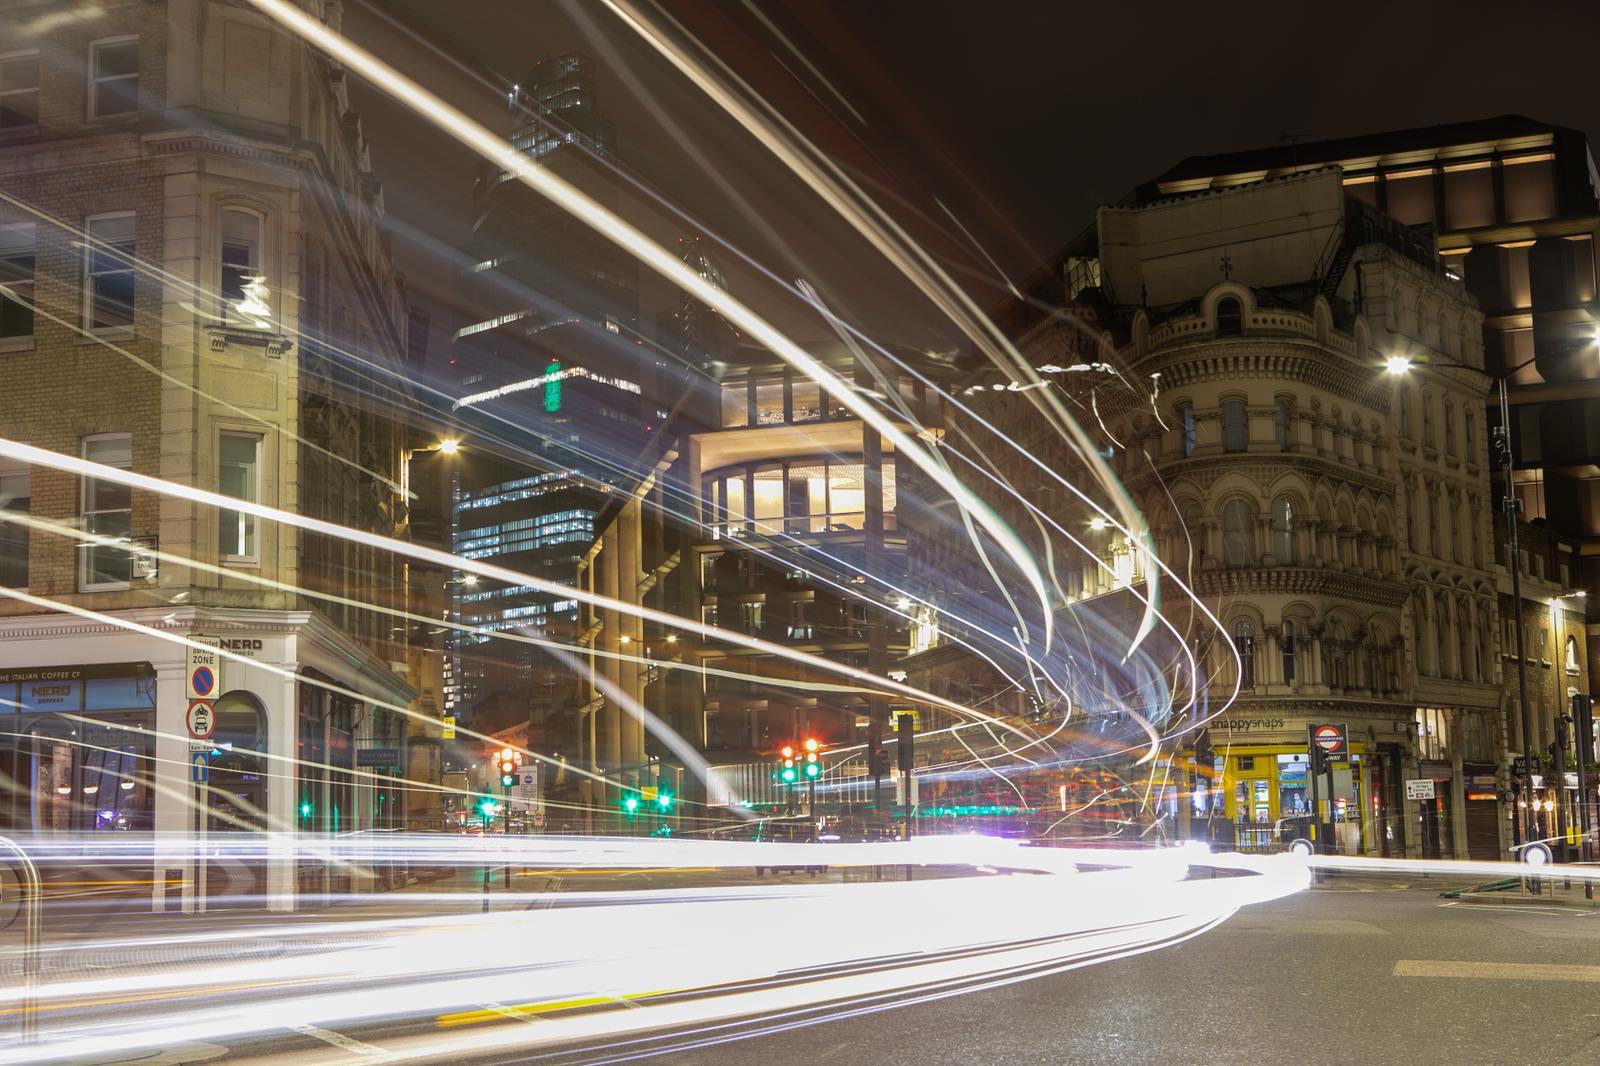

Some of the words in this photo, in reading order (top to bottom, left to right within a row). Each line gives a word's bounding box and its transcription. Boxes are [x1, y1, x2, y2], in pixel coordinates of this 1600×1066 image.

[193, 656, 214, 664] ZONE
[12, 673, 38, 681] ITALIAN
[41, 672, 70, 680] COFFEE
[1211, 718, 1284, 731] snappysnaps
[1515, 759, 1537, 767] VAE
